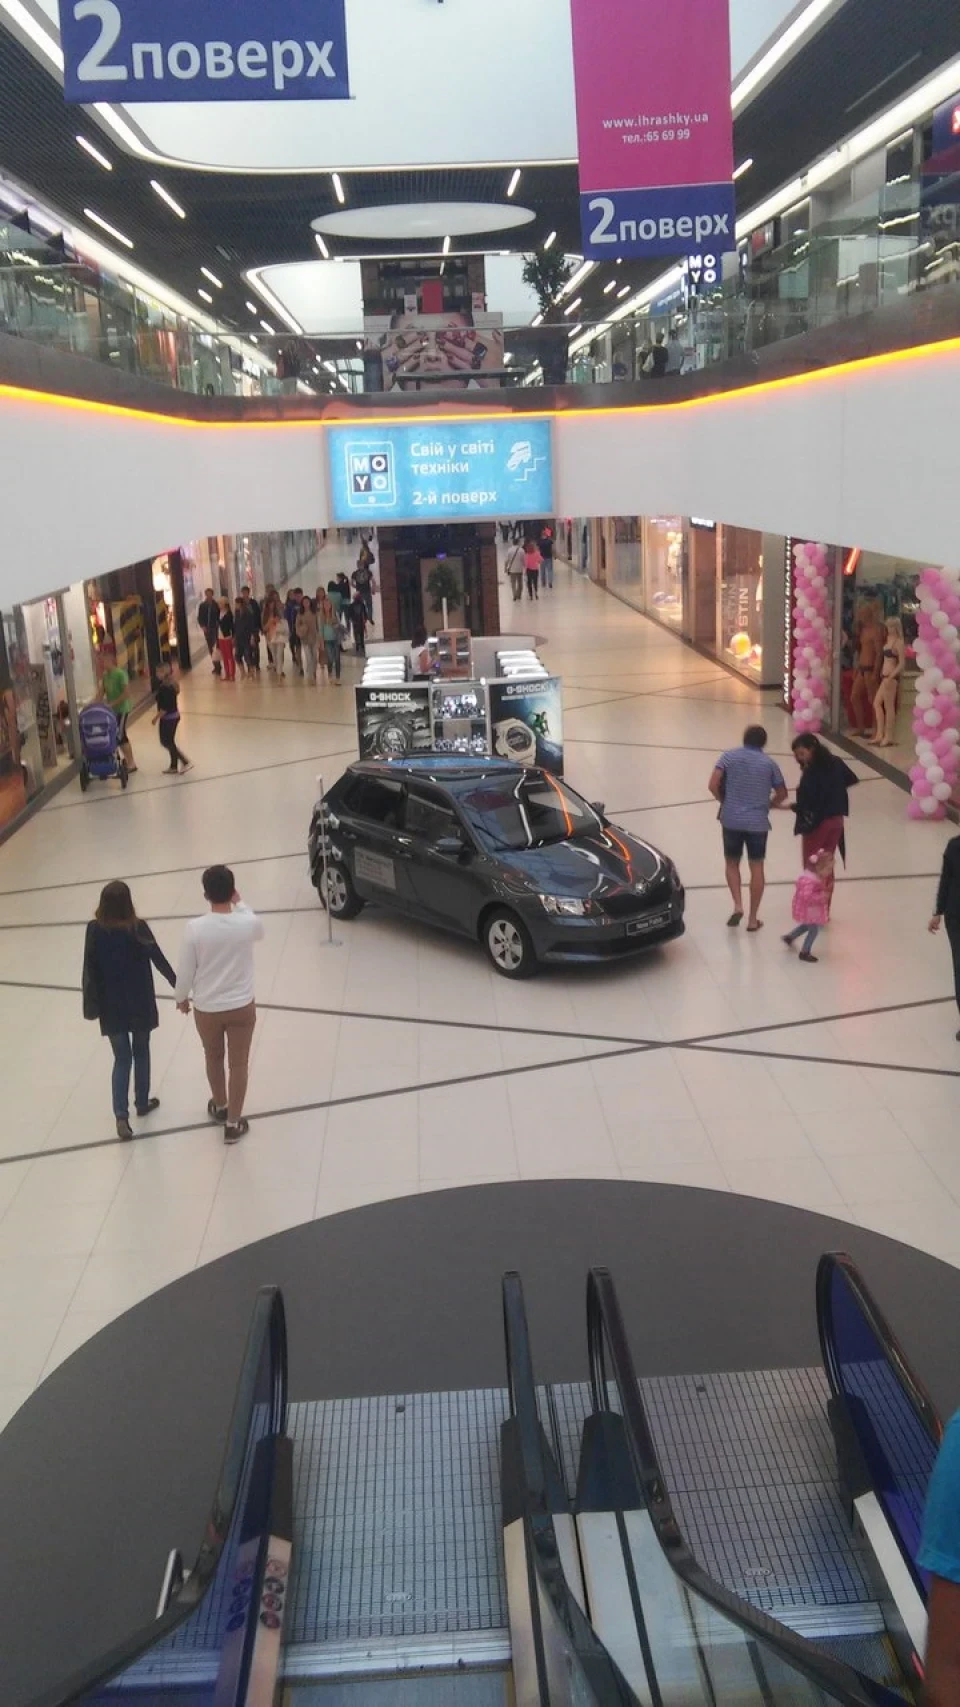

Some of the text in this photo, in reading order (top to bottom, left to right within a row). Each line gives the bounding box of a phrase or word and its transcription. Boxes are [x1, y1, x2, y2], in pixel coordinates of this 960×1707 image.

[73, 0, 336, 90] 2 поверх
[602, 112, 709, 129] www.ihrashky.ua
[662, 130, 675, 141] 69
[677, 129, 690, 140] 99
[588, 197, 729, 244] 2 поверх
[411, 440, 494, 459] Свій у світі
[411, 462, 469, 475] техніки
[413, 491, 497, 505] 2-й поверх
[369, 692, 411, 701] G-SHOCK
